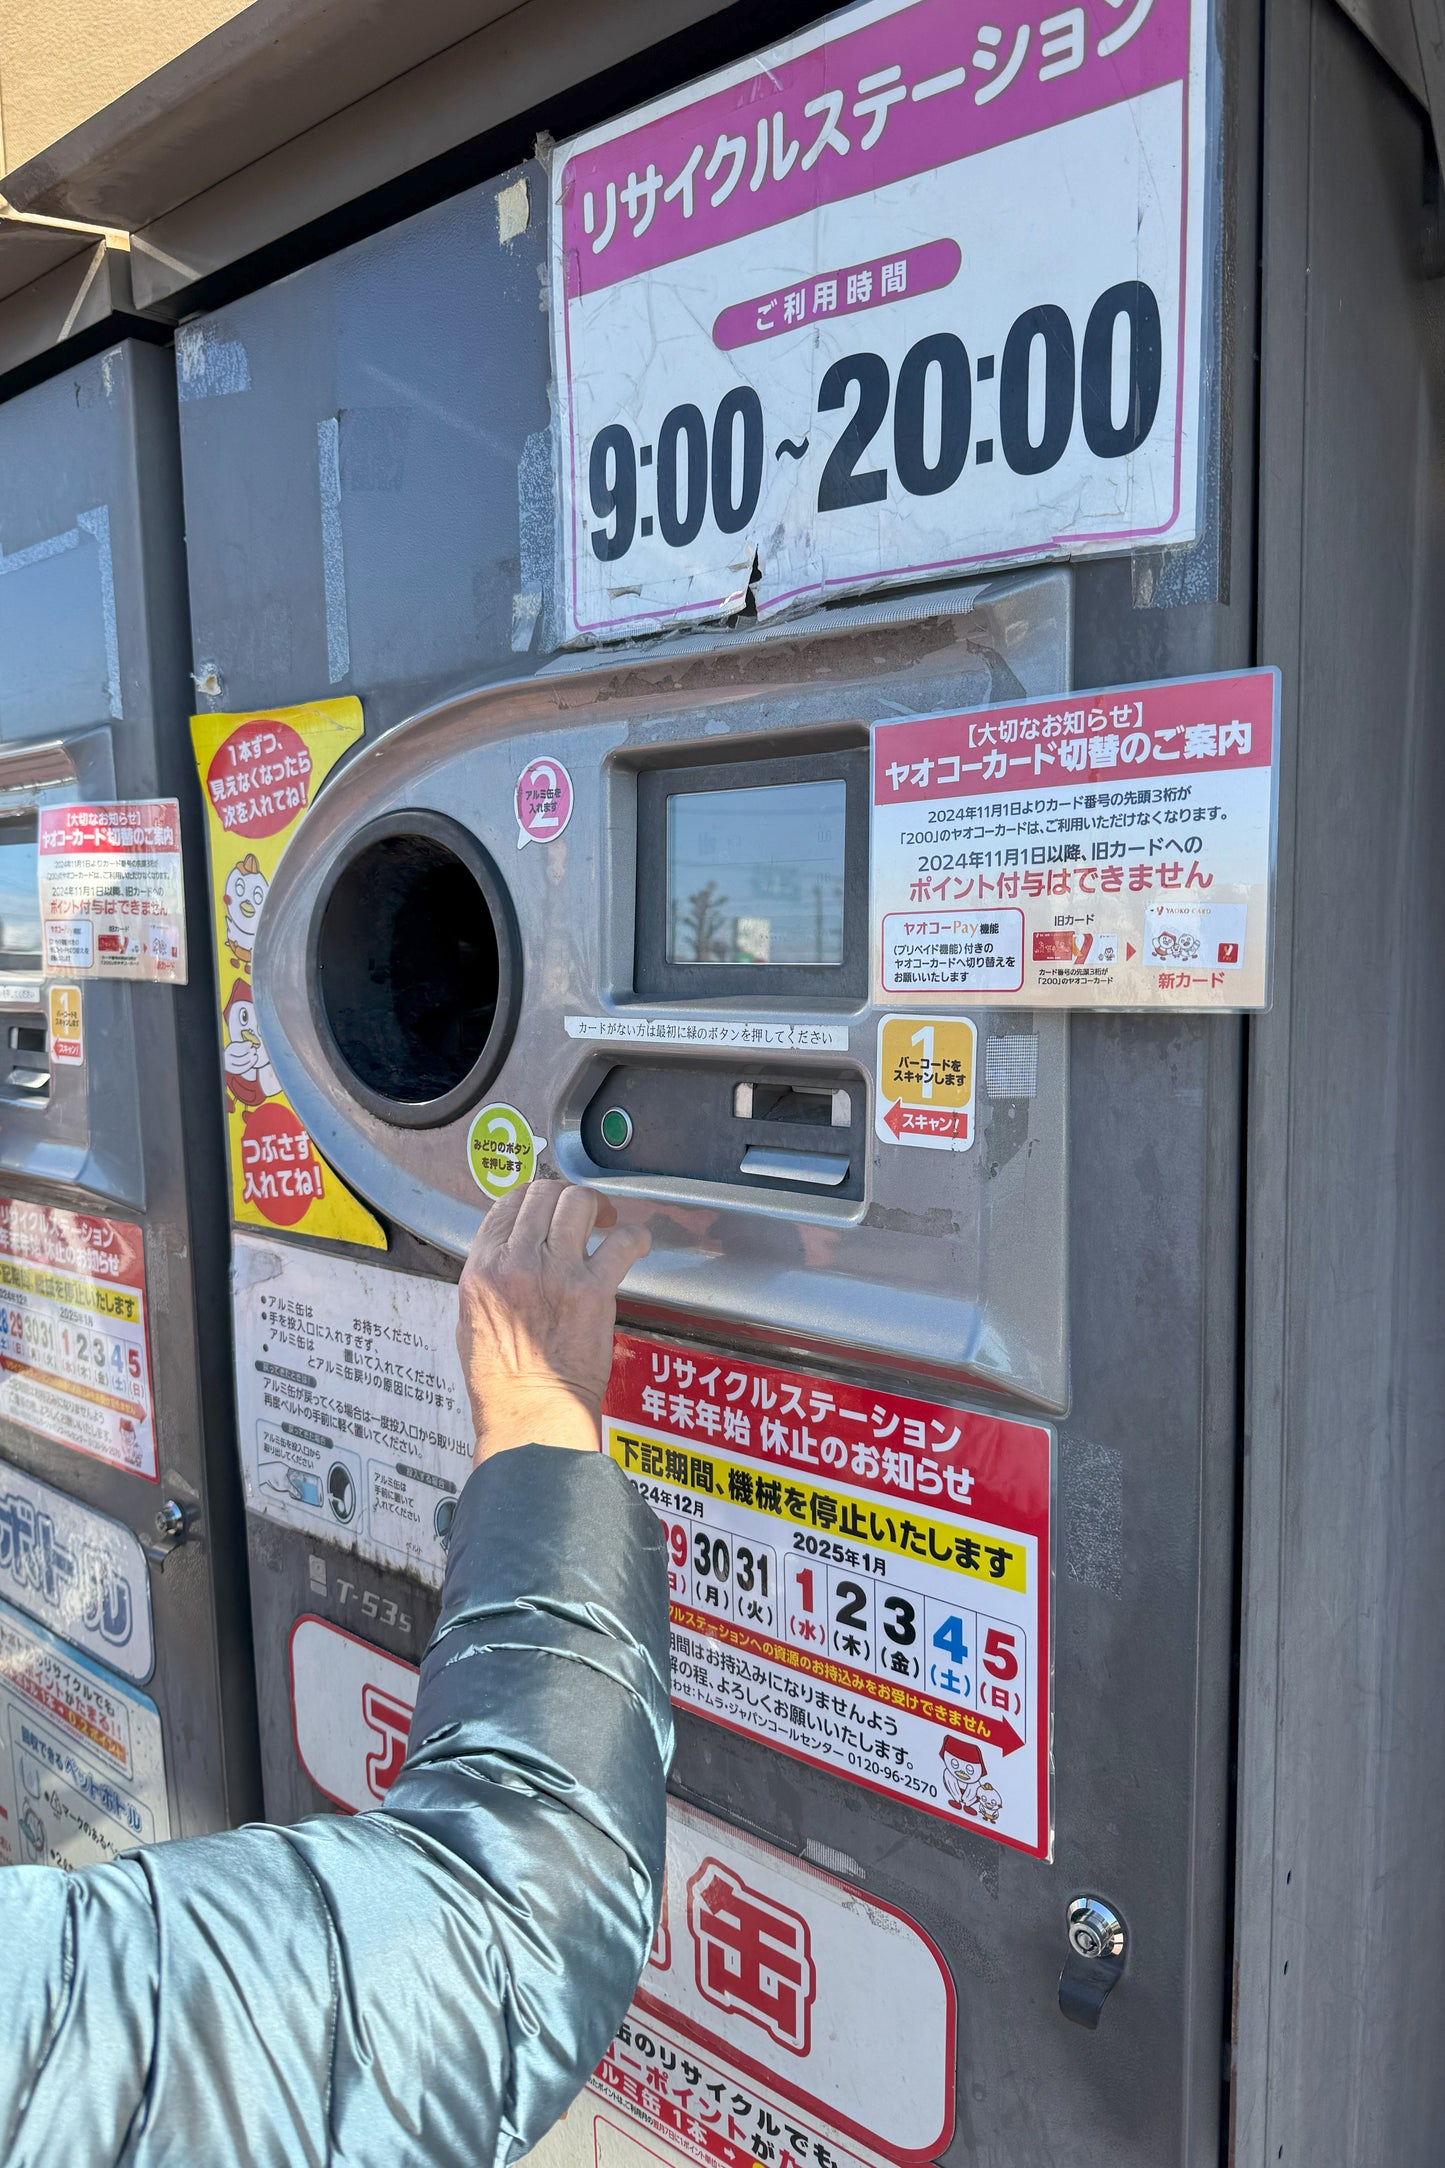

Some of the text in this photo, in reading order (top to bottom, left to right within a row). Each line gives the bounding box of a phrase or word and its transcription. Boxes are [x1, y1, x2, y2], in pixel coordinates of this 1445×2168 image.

[582, 0, 1154, 254] リサイクルステーション
[755, 260, 908, 332] ご利用時間
[227, 733, 283, 767] 1本ずつ、
[885, 720, 1253, 791] ヤオコーカード切替のご案内
[210, 750, 311, 802] 見えなくなったら
[525, 788, 562, 801] アルミ缶を
[222, 781, 306, 828] 次を入れてね!
[528, 764, 559, 829] 2
[529, 802, 558, 814] 入れます
[928, 785, 1193, 824] 2024年11月1日よりカード番号の先頭3桁が
[917, 836, 1204, 873] 2024年11月1日以降、旧カードへの
[909, 860, 1214, 903] ポイント付与はできません
[1054, 913, 1095, 926] 旧カード
[894, 972, 969, 983] お願いいたします
[895, 956, 1015, 969] ヤオコーカードへ切り替えを
[1158, 972, 1225, 990] 新カード
[577, 1021, 833, 1046] カードがない方は最初に緑のボタンを押してください
[893, 1070, 966, 1086] スキャンします
[898, 1056, 961, 1072] バーコードを
[911, 1026, 934, 1098] 1
[902, 1113, 960, 1132] スキャン!
[474, 1139, 531, 1155] みどりのボタン
[482, 1157, 523, 1172] を押します
[487, 1117, 520, 1188] 3
[244, 1165, 323, 1200] 入れてね!
[268, 1295, 429, 1351] アルミ缶は お持ちください。
[270, 1328, 315, 1351] アルミ缶は
[111, 1344, 123, 1373] 4
[128, 1348, 141, 1378] 5
[650, 1352, 961, 1453] リサイクルステーション
[641, 1385, 975, 1504] 年末年始 休止のお知らせ
[616, 1434, 1013, 1579] 下記期間、機械を停止いたします
[631, 1479, 887, 1577] 24年12月 2025年1月
[693, 1532, 730, 1583] 30
[736, 1546, 768, 1597] 31
[795, 1568, 815, 1613] 1
[835, 1580, 867, 1631] 2
[884, 1596, 916, 1646] 3
[932, 1615, 968, 1664] 4
[983, 1627, 1019, 1682] 5
[671, 1678, 937, 1798] わせ:トムラ・ジャパンコールセンター 0120-96-2570
